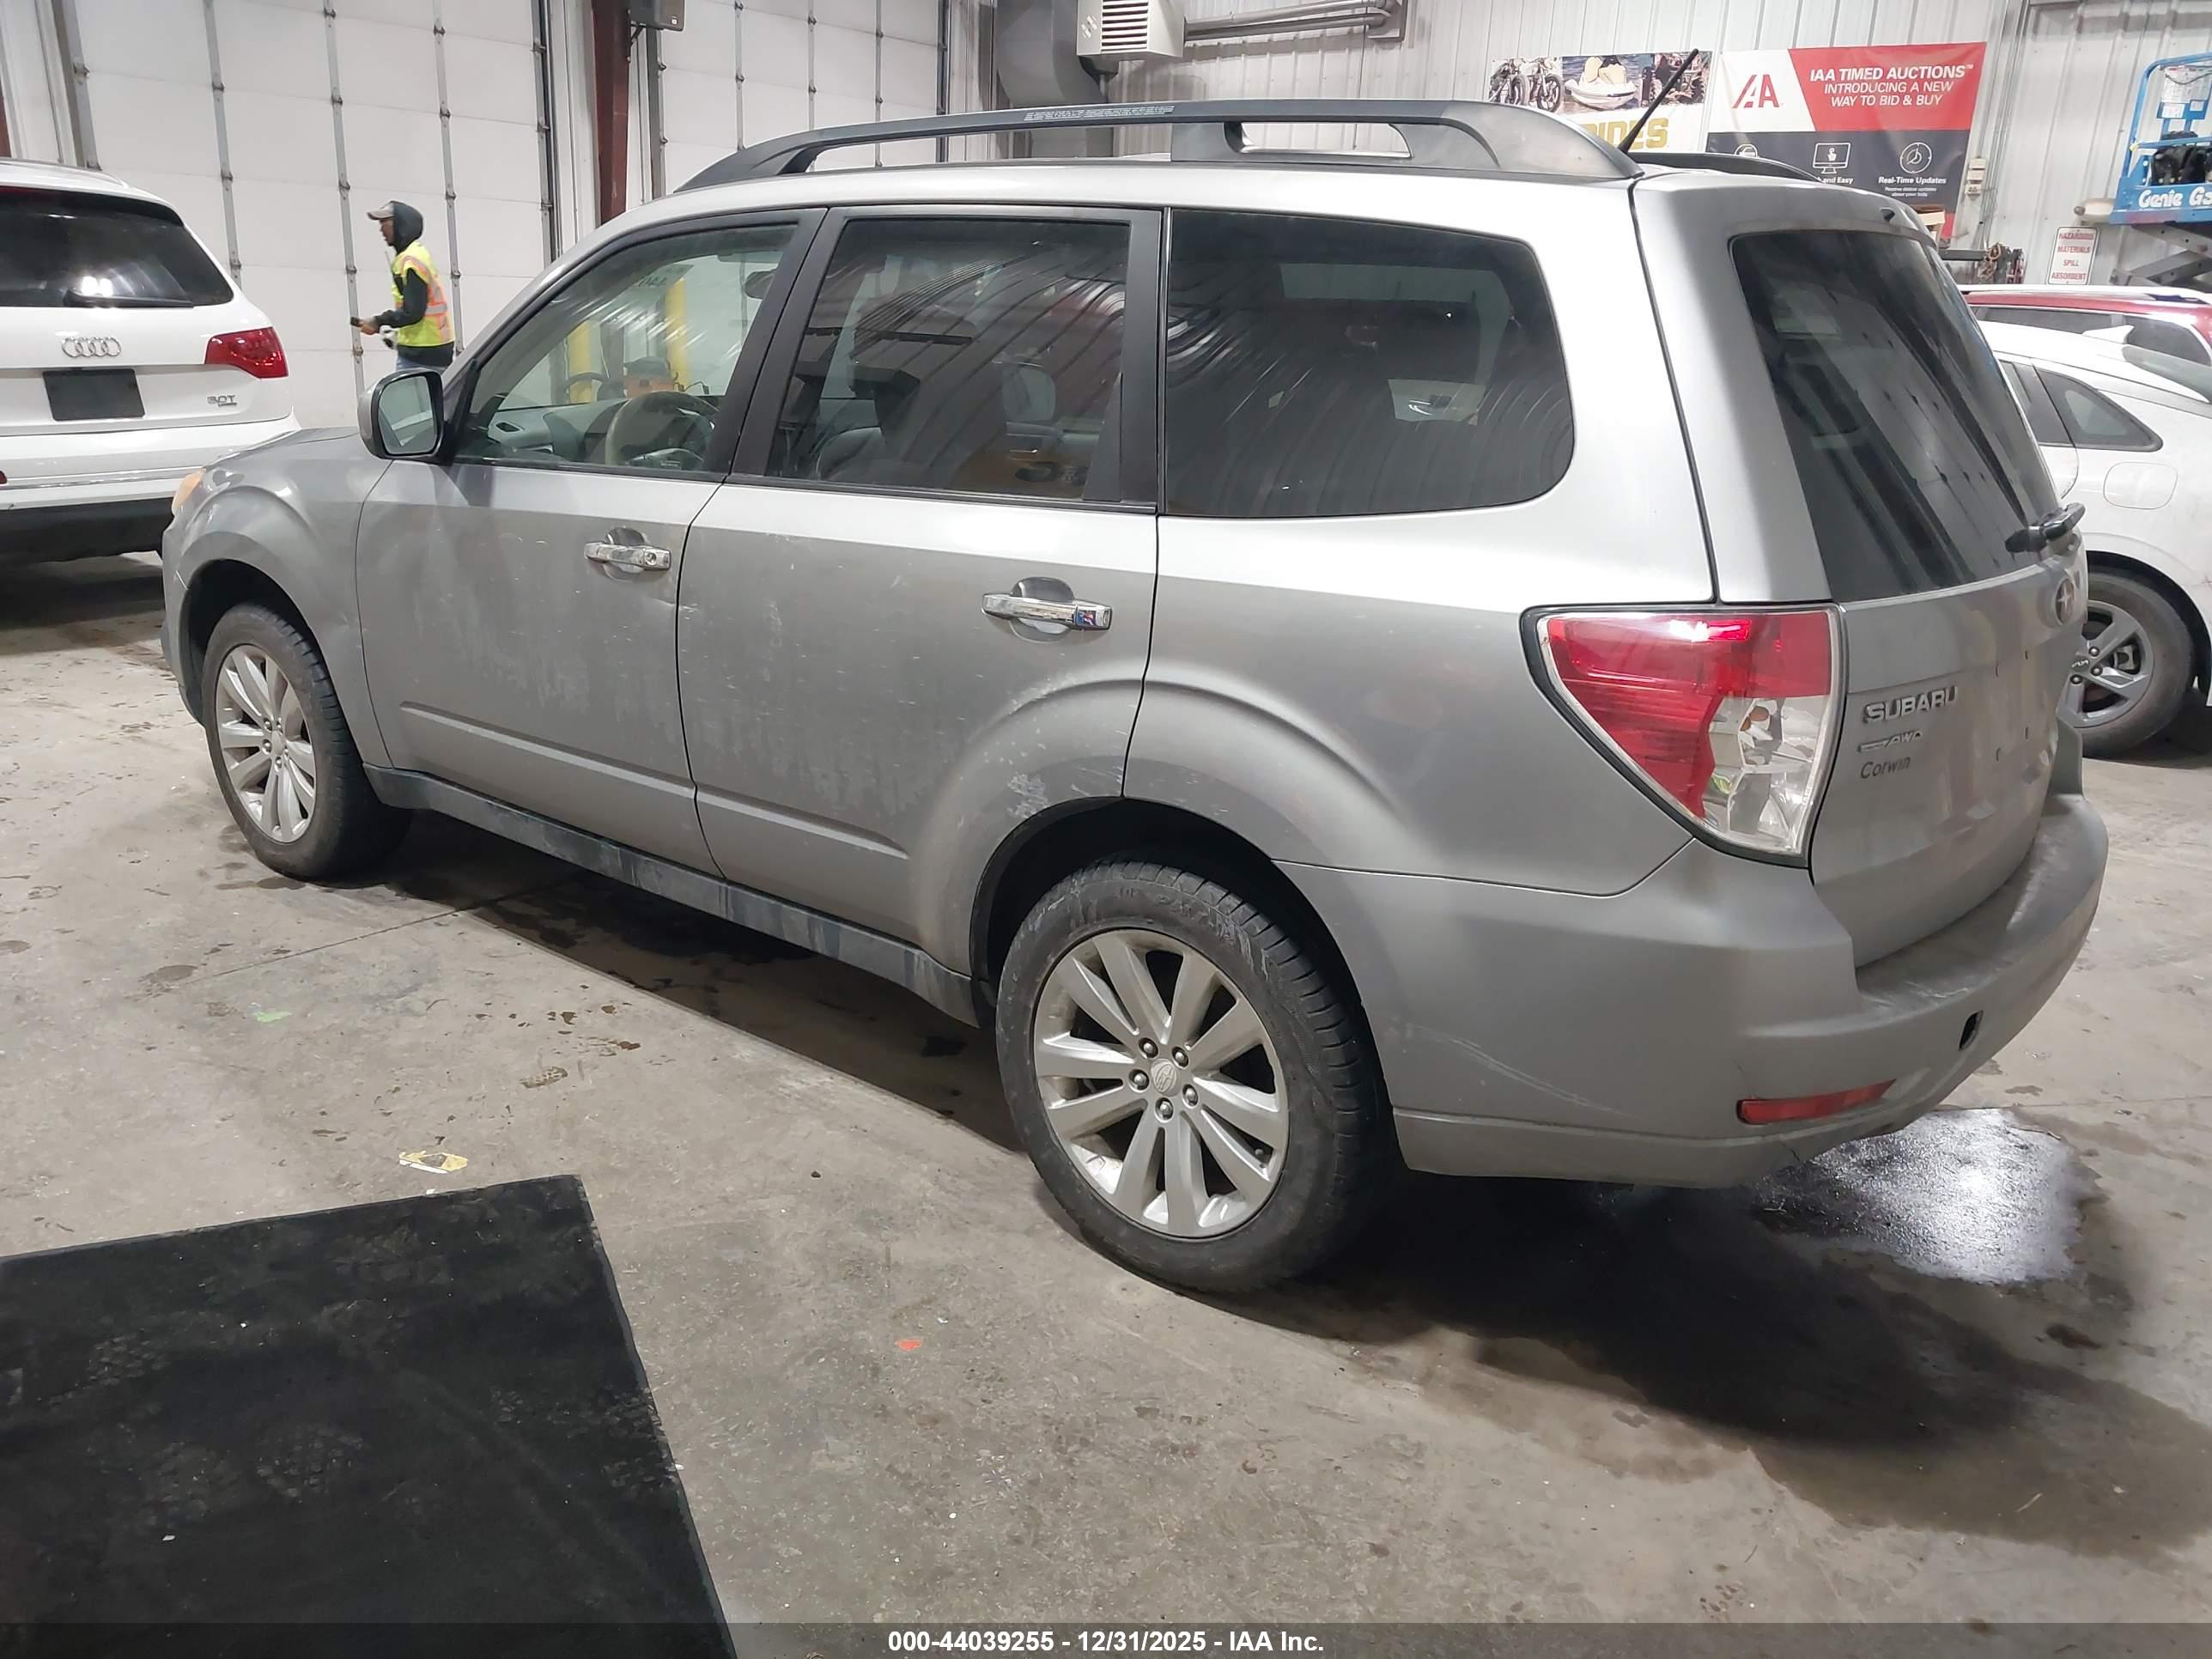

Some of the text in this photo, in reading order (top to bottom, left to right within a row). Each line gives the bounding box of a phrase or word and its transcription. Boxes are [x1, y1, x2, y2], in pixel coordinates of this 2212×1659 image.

[1809, 69, 1835, 82] IAA
[1839, 67, 1883, 81] TIMED
[1824, 81, 1954, 94] INTRODUCING A NEW
[1831, 93, 1942, 106] WAY TO BID & BUY
[1837, 176, 1853, 185] Easy
[1916, 176, 1948, 185] Updates
[2138, 188, 2184, 208] Genie
[1863, 685, 1958, 724] SUBARU
[1860, 757, 1911, 779] Corwin
